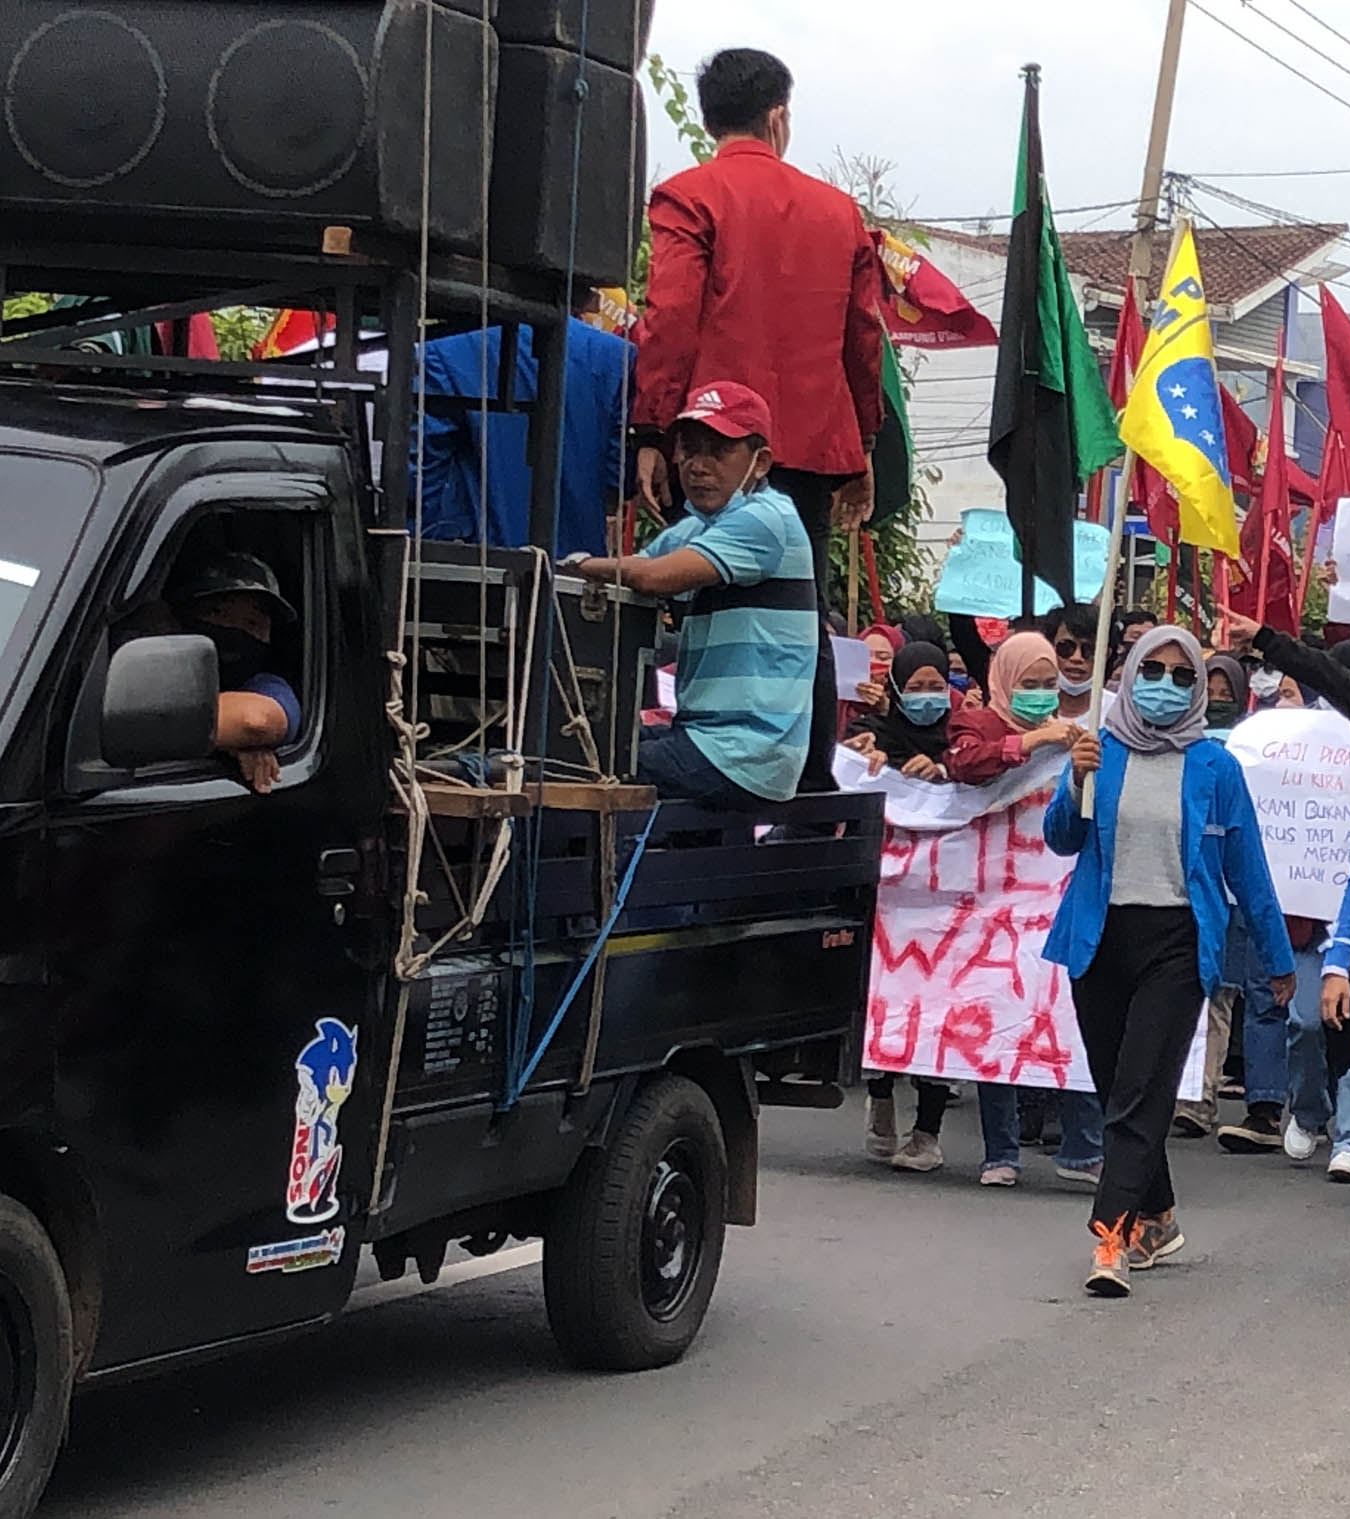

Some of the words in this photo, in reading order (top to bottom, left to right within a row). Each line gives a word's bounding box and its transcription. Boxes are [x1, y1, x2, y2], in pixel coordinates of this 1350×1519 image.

[1262, 741, 1308, 762] GAJI
[1282, 769, 1302, 785] LU
[1311, 773, 1344, 791] KIRA
[1257, 794, 1296, 818] KAMI
[1306, 828, 1334, 843] TAPI
